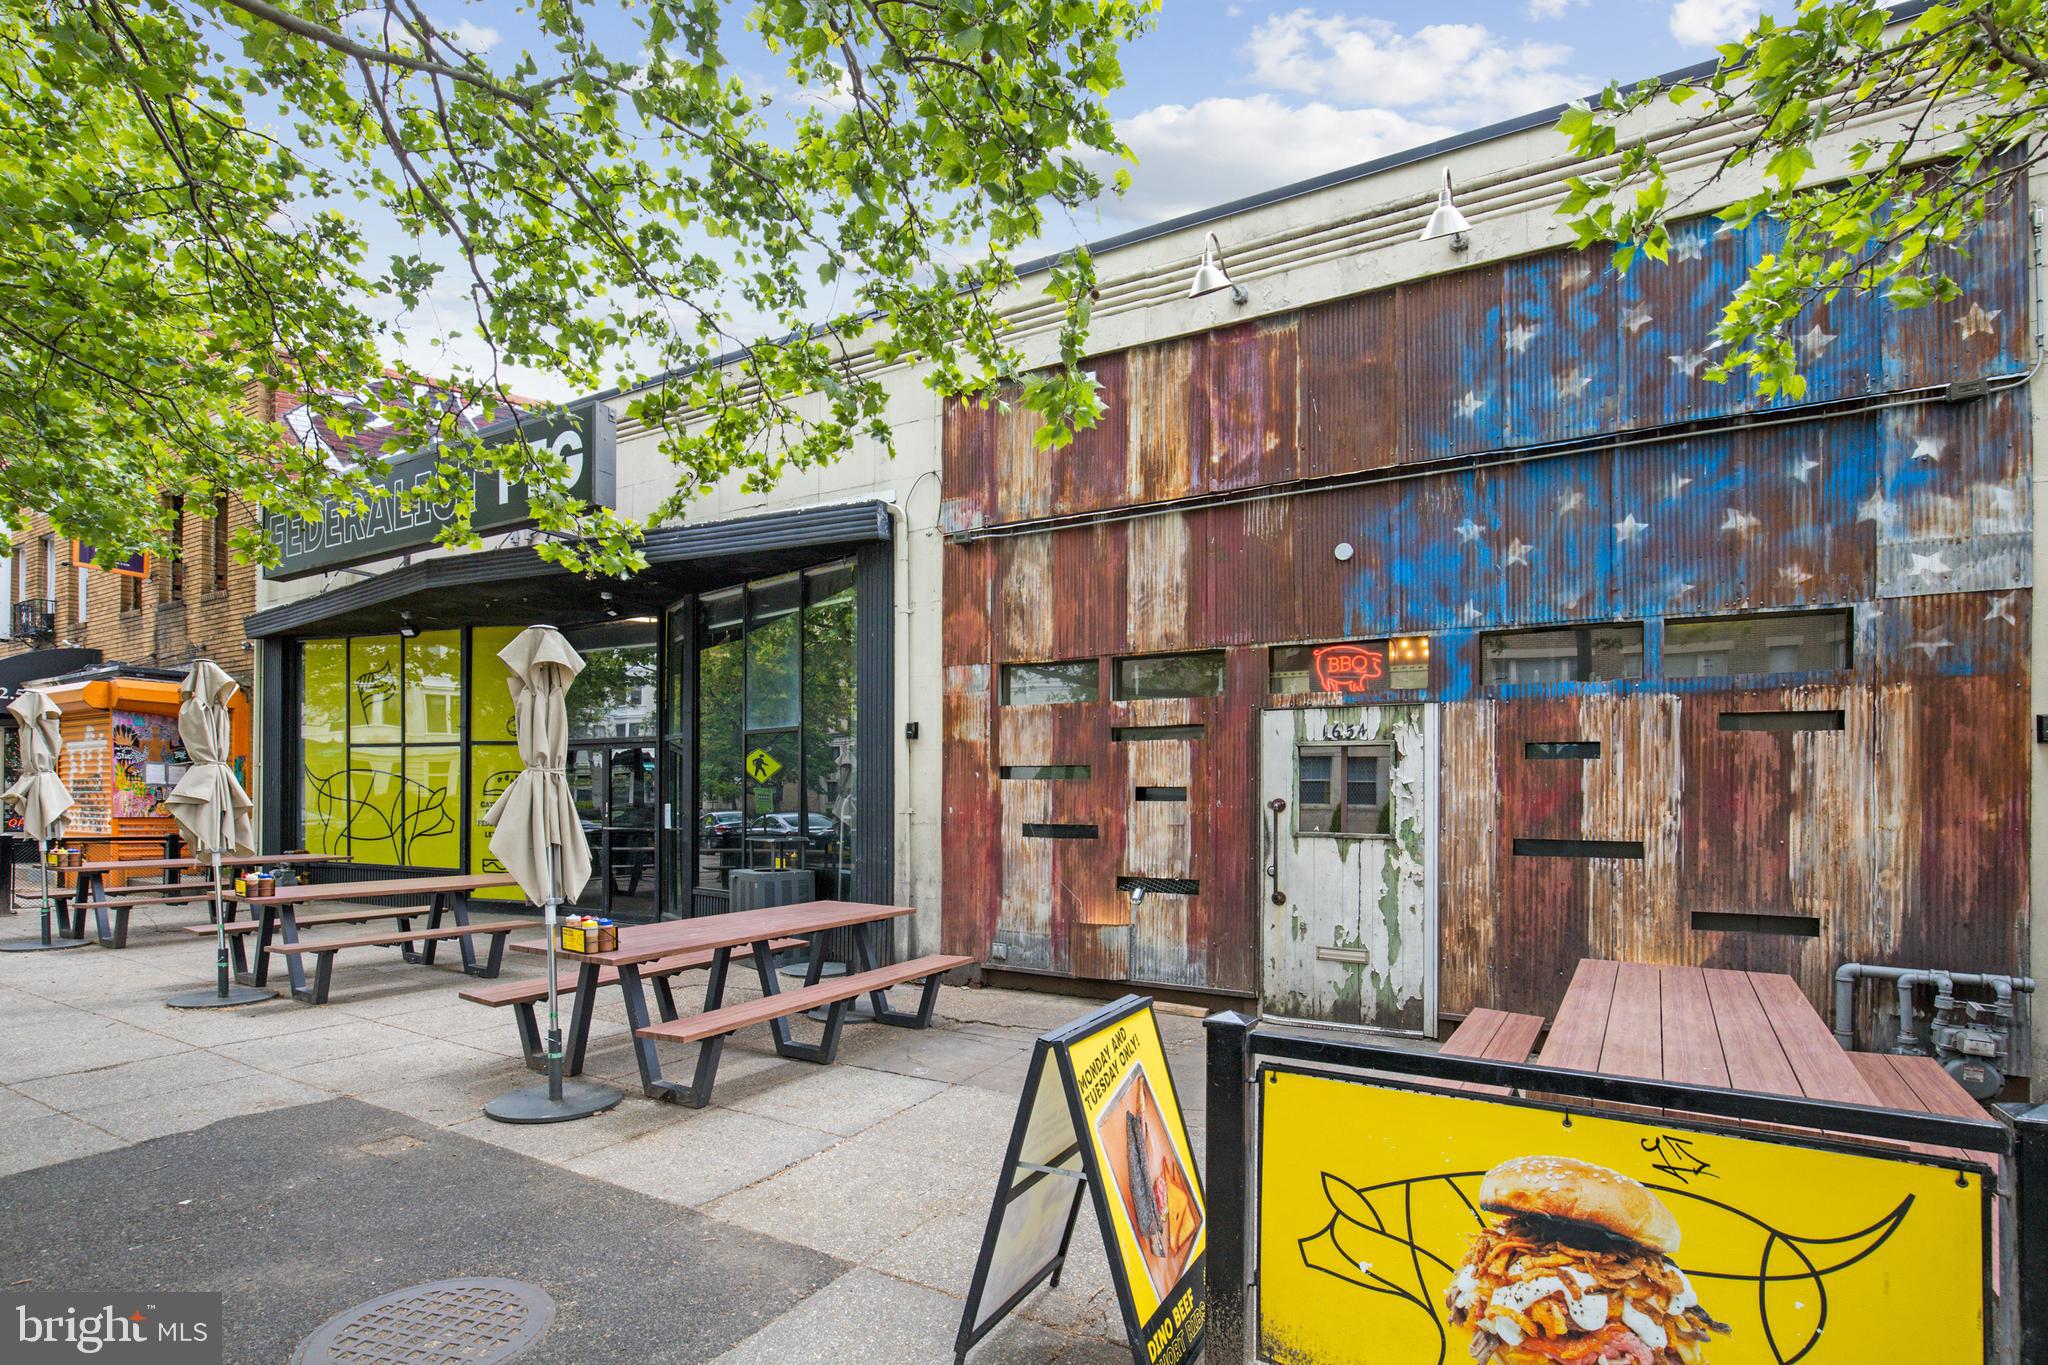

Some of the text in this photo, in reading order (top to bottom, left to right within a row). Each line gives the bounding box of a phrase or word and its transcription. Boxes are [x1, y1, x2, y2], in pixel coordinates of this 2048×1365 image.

[1328, 655, 1367, 673] BBQ
[1323, 722, 1368, 740] 1654
[1078, 1027, 1127, 1094] MONDAY AND
[1085, 1033, 1141, 1110] TUESDAY ONLY!
[1147, 1287, 1194, 1364] DINO BEEF
[1155, 1329, 1187, 1365] HORT
